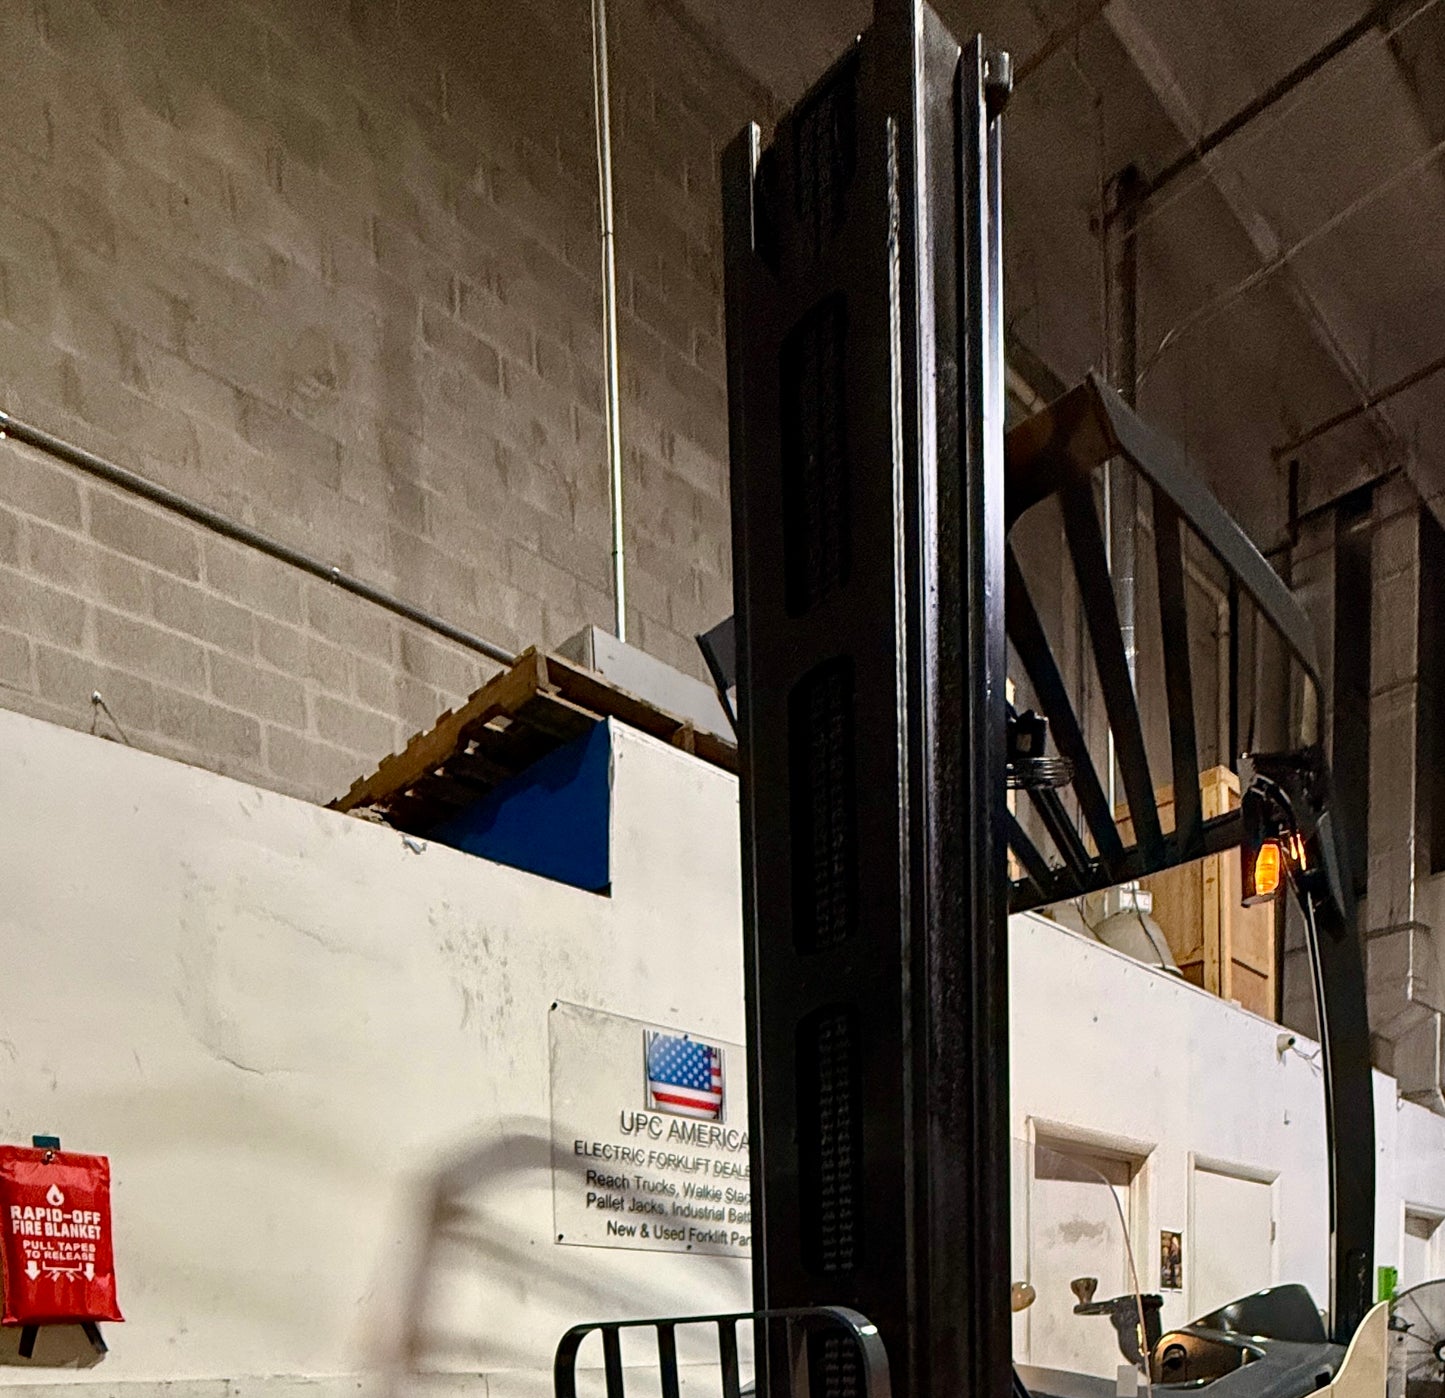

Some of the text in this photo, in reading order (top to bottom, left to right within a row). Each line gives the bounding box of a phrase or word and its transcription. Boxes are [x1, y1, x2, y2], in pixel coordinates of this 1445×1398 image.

[620, 1110, 749, 1150] UPC AMERICA
[574, 1140, 645, 1164] ELECTRIC
[648, 1151, 711, 1174] FORKLIFT
[586, 1169, 630, 1190] Reach
[634, 1175, 680, 1198] Trucks,
[682, 1182, 723, 1201] Walkie
[10, 1205, 101, 1225] RAPID-OFF
[586, 1192, 625, 1212] Pallet
[628, 1198, 669, 1216] Jacks,
[671, 1201, 725, 1221] Industrial
[12, 1219, 101, 1240] FIRE BLANKET
[607, 1220, 637, 1237] New
[640, 1223, 650, 1238] &
[653, 1225, 686, 1241] Used
[688, 1227, 728, 1245] Forklift
[23, 1240, 96, 1253] PULL TAPES
[24, 1249, 96, 1261] TO RELEASE
